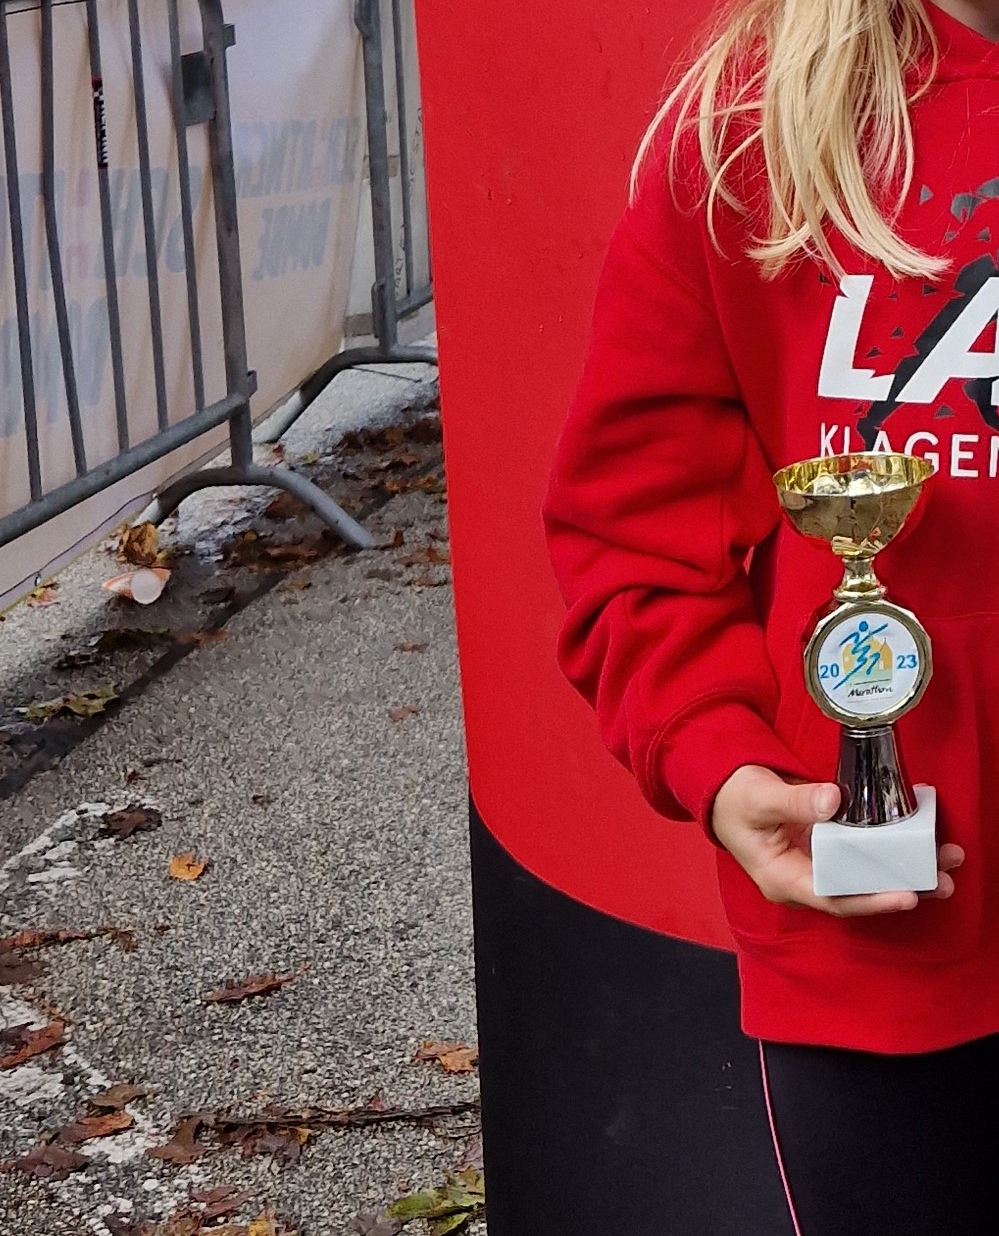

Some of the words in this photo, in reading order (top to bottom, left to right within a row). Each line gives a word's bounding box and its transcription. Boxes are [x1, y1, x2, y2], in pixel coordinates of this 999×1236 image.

[820, 663, 840, 679] 20
[896, 654, 918, 669] 23
[847, 684, 894, 698] Marathon
